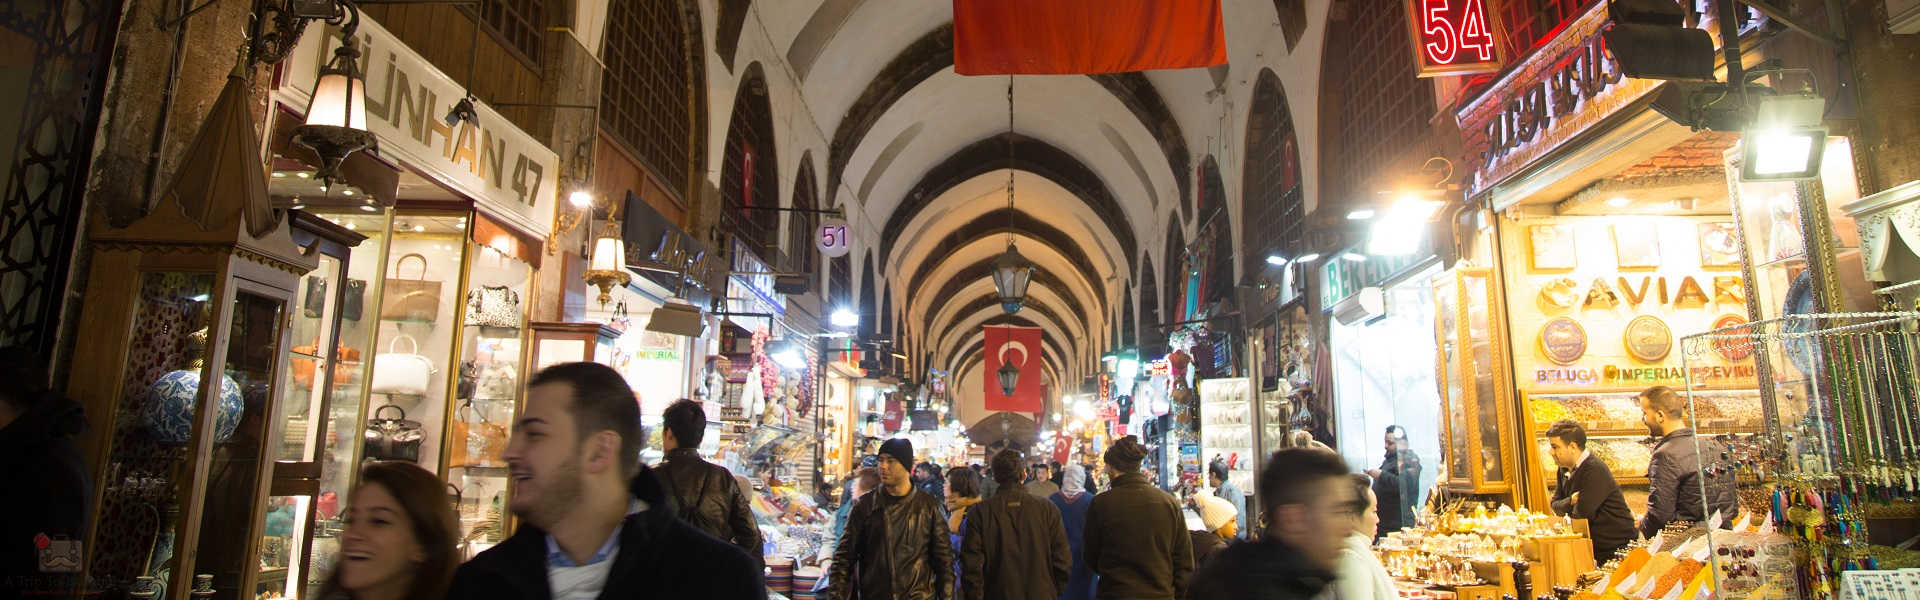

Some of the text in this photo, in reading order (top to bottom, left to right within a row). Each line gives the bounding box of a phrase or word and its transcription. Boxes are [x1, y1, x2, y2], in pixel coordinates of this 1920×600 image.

[1424, 0, 1494, 65] 54
[511, 152, 543, 207] 47
[822, 226, 848, 248] 51
[1536, 275, 1747, 310] CAVIAR
[1536, 369, 1598, 382] BELUGA
